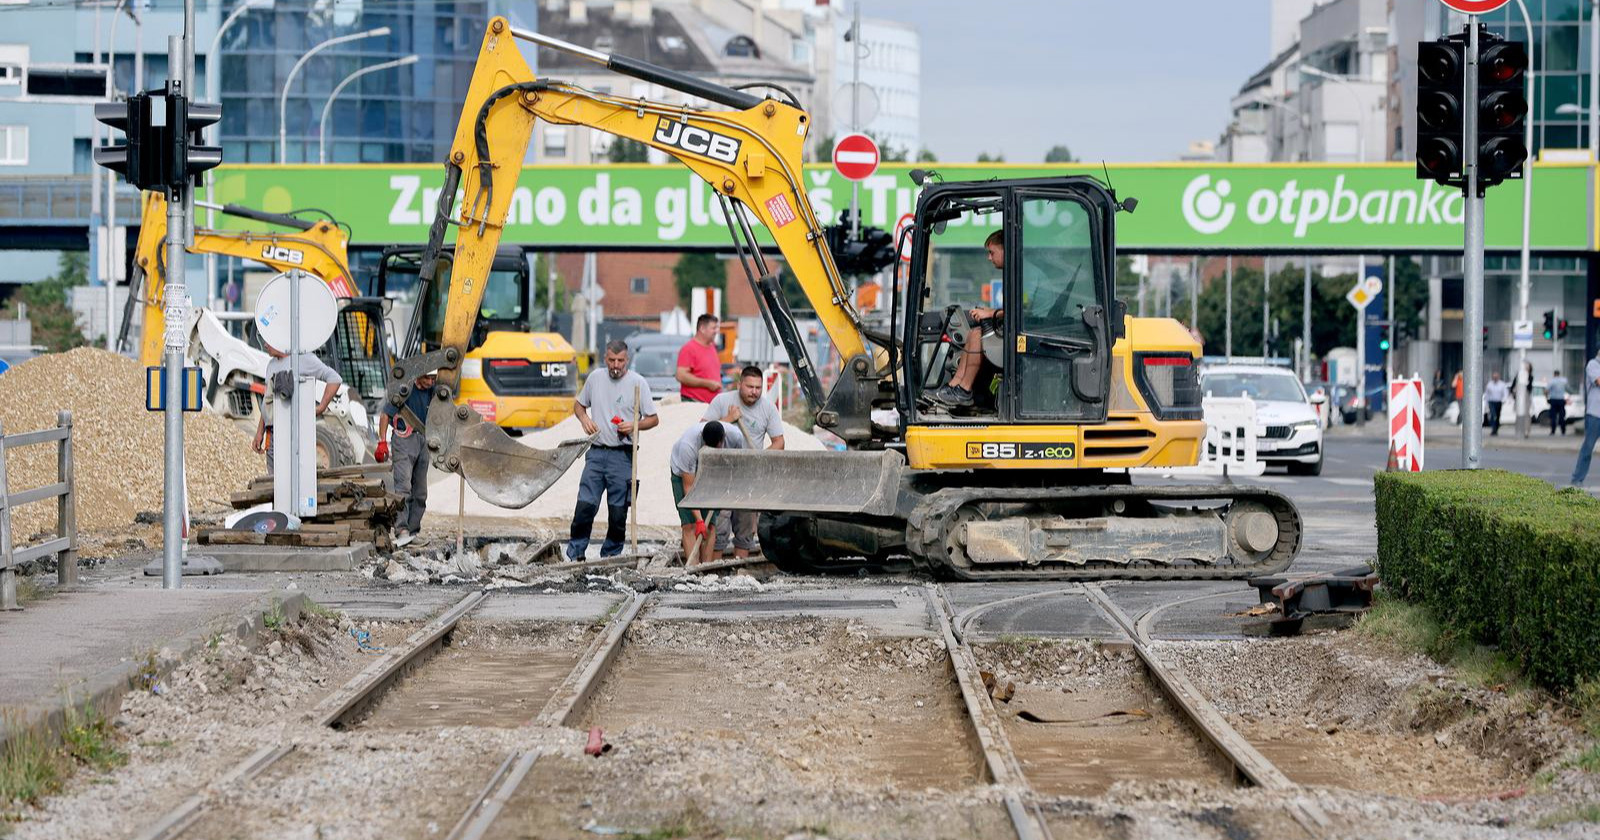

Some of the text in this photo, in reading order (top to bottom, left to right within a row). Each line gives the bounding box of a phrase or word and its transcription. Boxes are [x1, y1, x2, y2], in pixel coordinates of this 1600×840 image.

[656, 122, 739, 162] JCB
[578, 173, 642, 226] da
[1247, 174, 1466, 237] otpbanka
[263, 246, 303, 264] JCB
[541, 364, 567, 377] JCB
[982, 443, 1016, 458] 85
